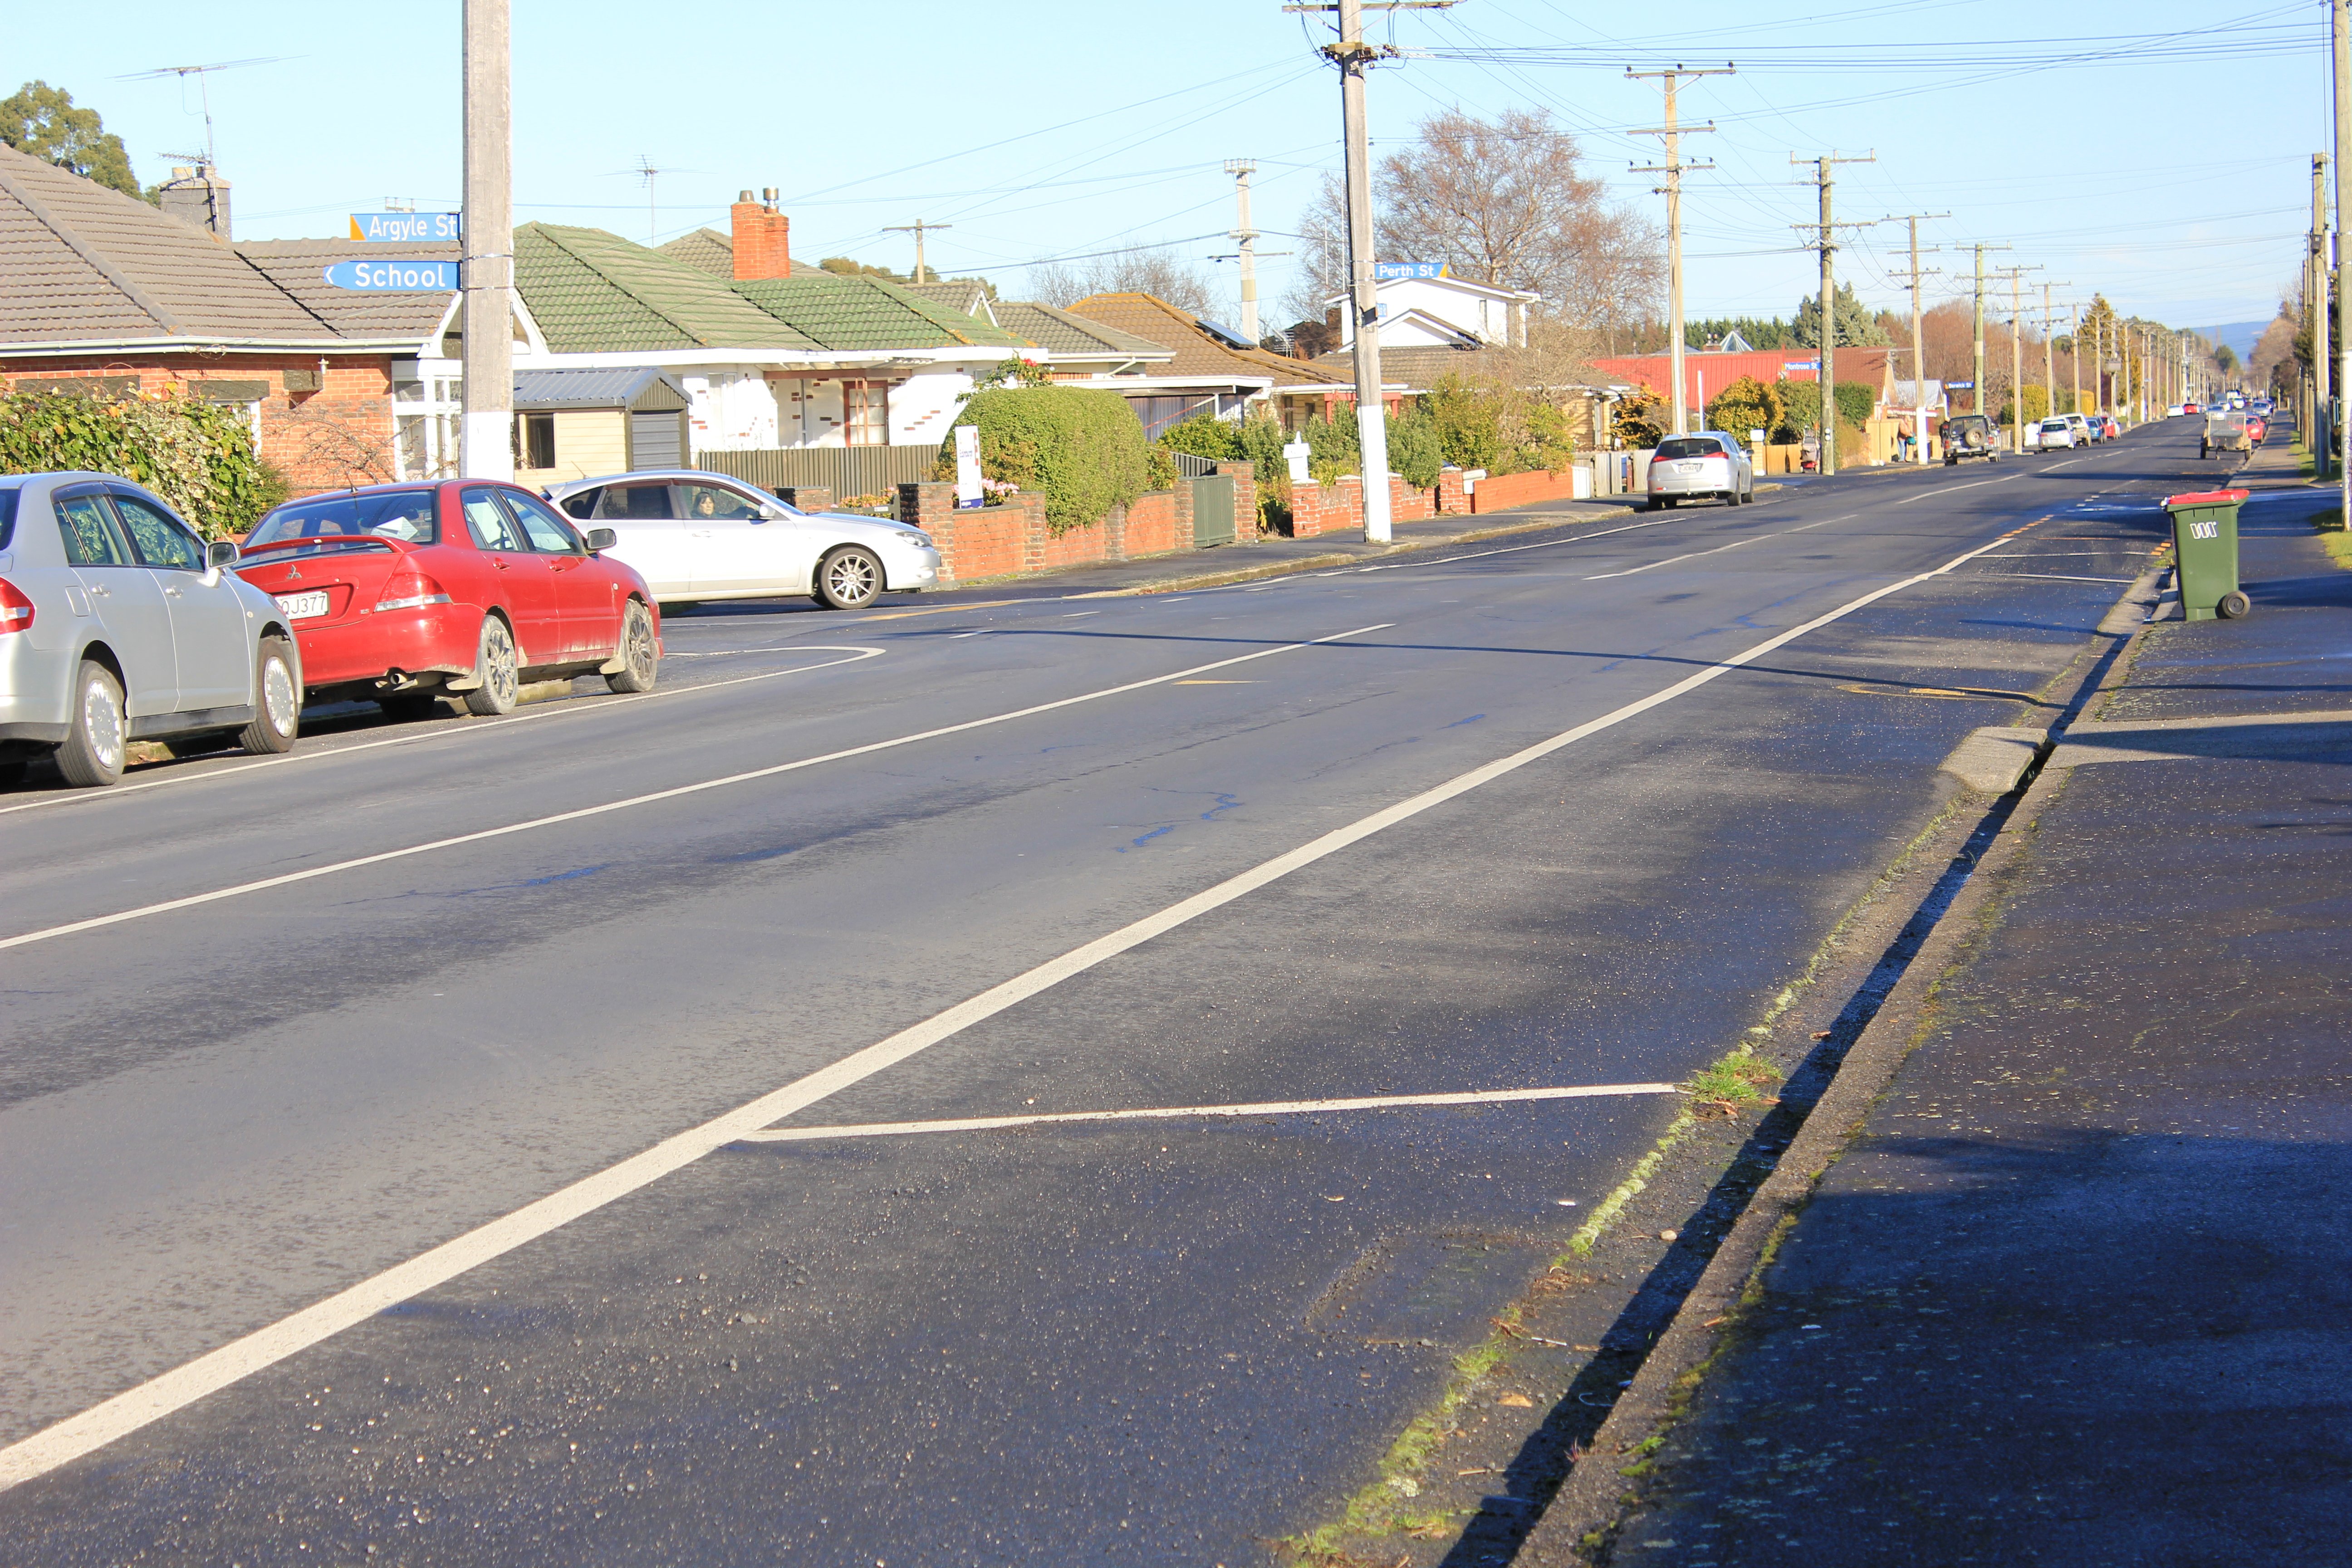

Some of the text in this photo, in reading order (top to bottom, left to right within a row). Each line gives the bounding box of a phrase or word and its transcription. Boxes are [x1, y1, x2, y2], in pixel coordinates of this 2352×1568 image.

[369, 215, 457, 241] Argyle St
[355, 263, 446, 287] School
[1379, 265, 1434, 277] Perth St
[281, 595, 326, 615] QJ377
